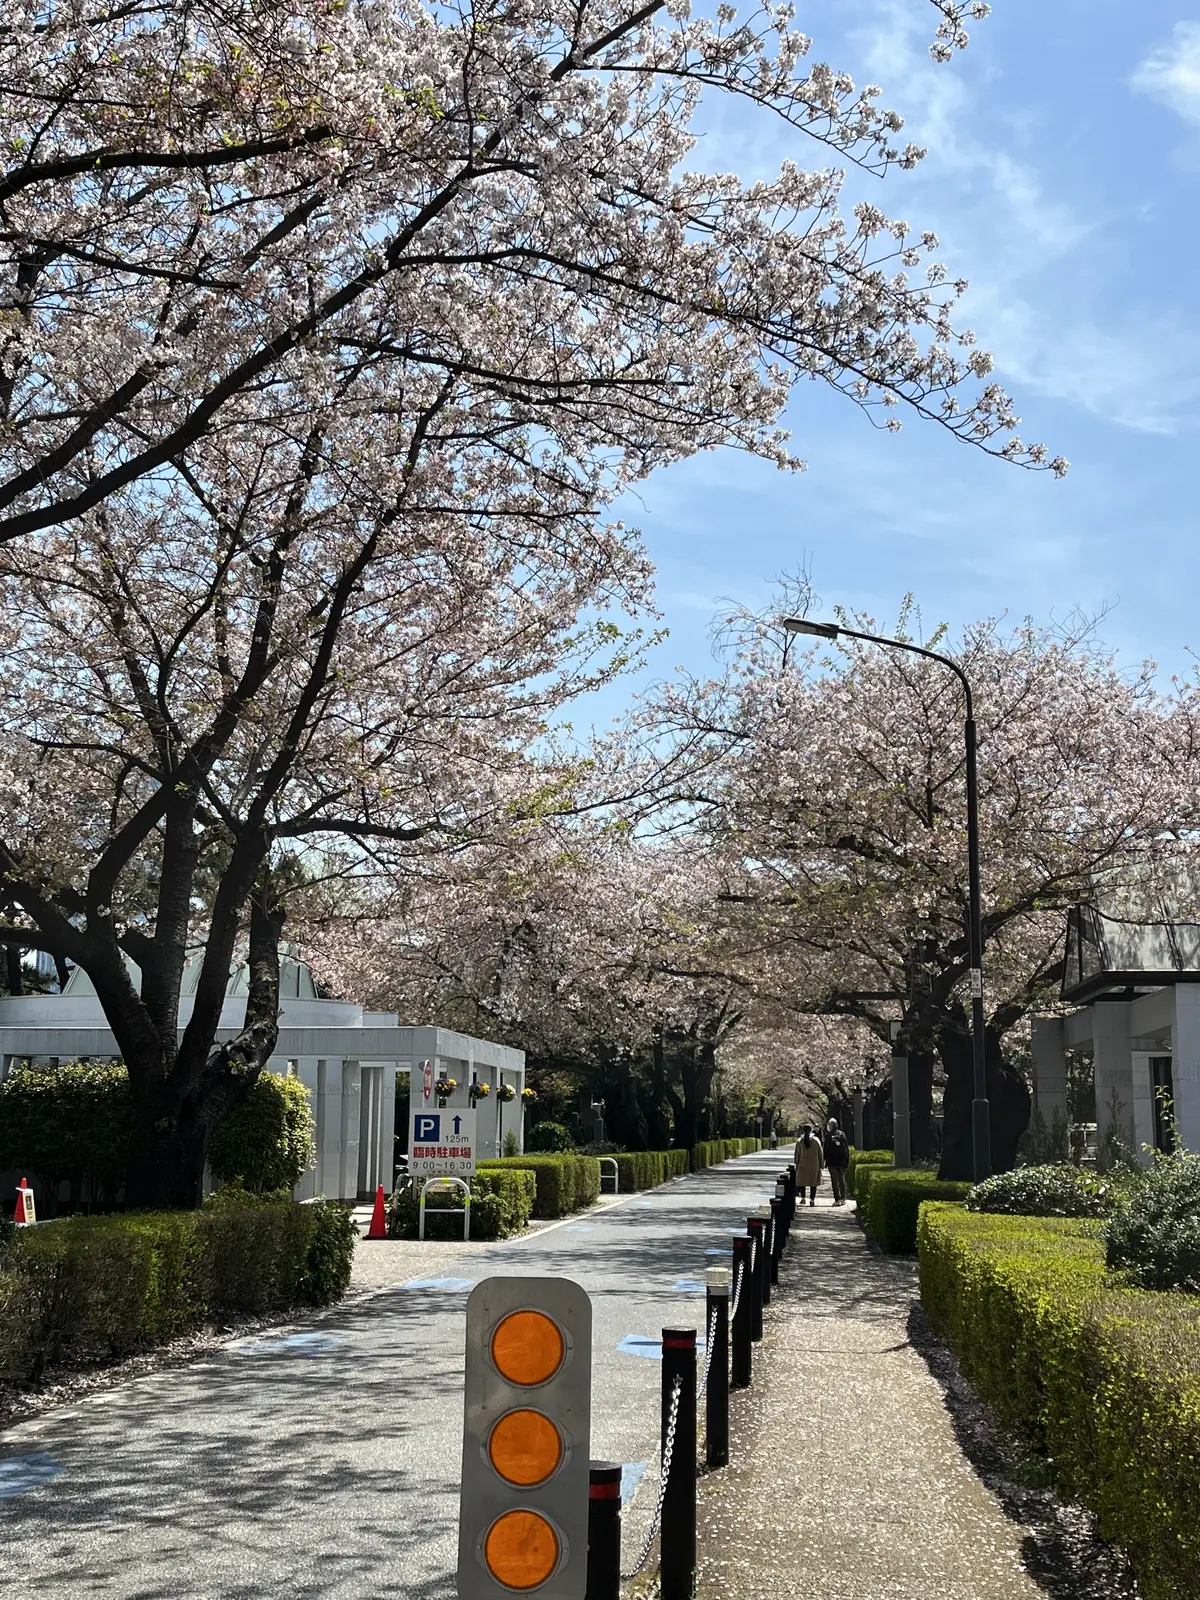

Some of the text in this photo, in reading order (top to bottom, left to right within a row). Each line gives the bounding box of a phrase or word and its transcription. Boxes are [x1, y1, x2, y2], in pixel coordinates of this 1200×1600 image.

[420, 1119, 435, 1138] P
[413, 1147, 472, 1159] 臨時駐車場
